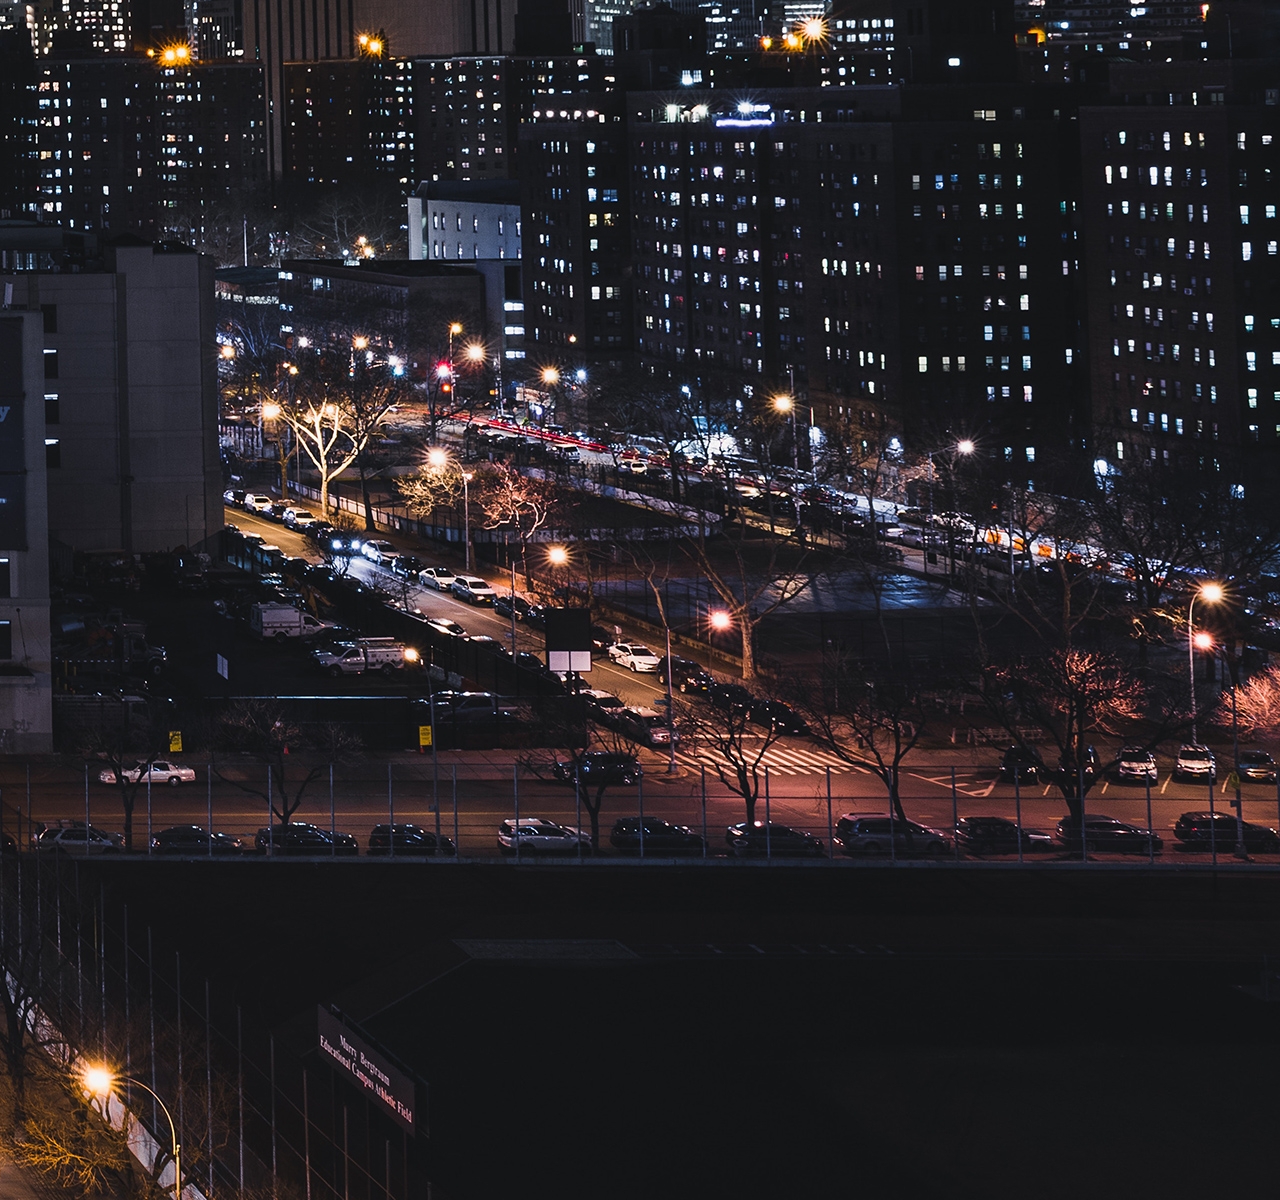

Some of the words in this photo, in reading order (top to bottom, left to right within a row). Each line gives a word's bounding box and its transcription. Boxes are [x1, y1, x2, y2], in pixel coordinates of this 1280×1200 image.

[320, 1034, 351, 1071] Educational
[351, 1062, 375, 1091] Campus
[374, 1082, 397, 1110] Athletic
[397, 1100, 413, 1125] Field
[339, 1034, 358, 1061] Murry
[360, 1051, 391, 1087] Bergtraum
